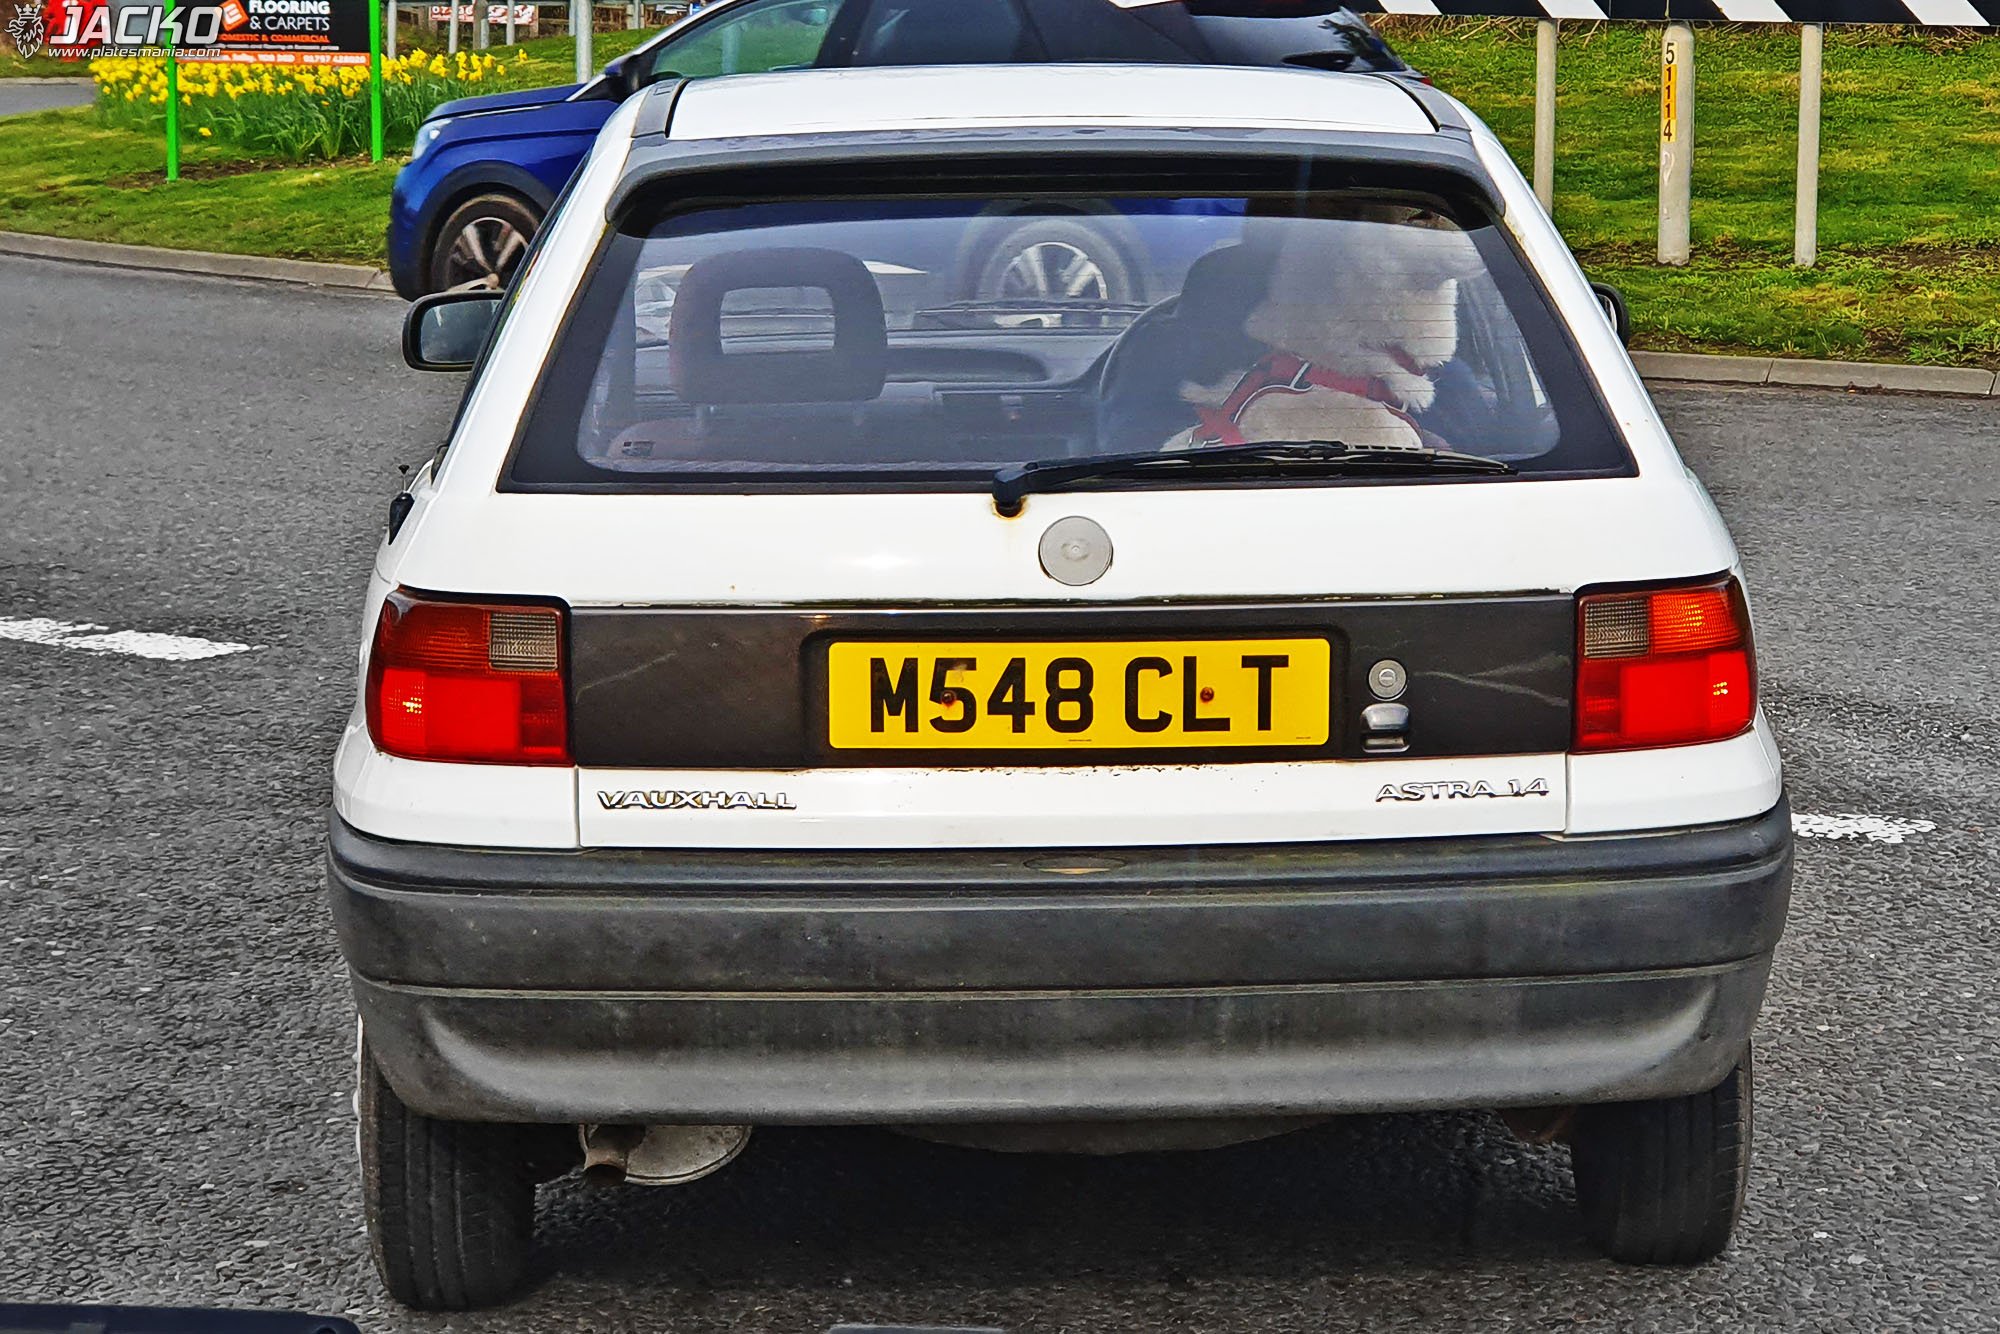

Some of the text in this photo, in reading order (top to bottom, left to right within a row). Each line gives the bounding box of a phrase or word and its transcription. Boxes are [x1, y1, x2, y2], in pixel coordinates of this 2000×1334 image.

[249, 0, 330, 14] FLOORING
[249, 16, 330, 31] & CARPETS
[217, 33, 260, 42] OMESTIC
[869, 654, 1290, 734] M548 CLT
[597, 790, 797, 810] VAUXHALL
[1375, 780, 1496, 803] ASTRA
